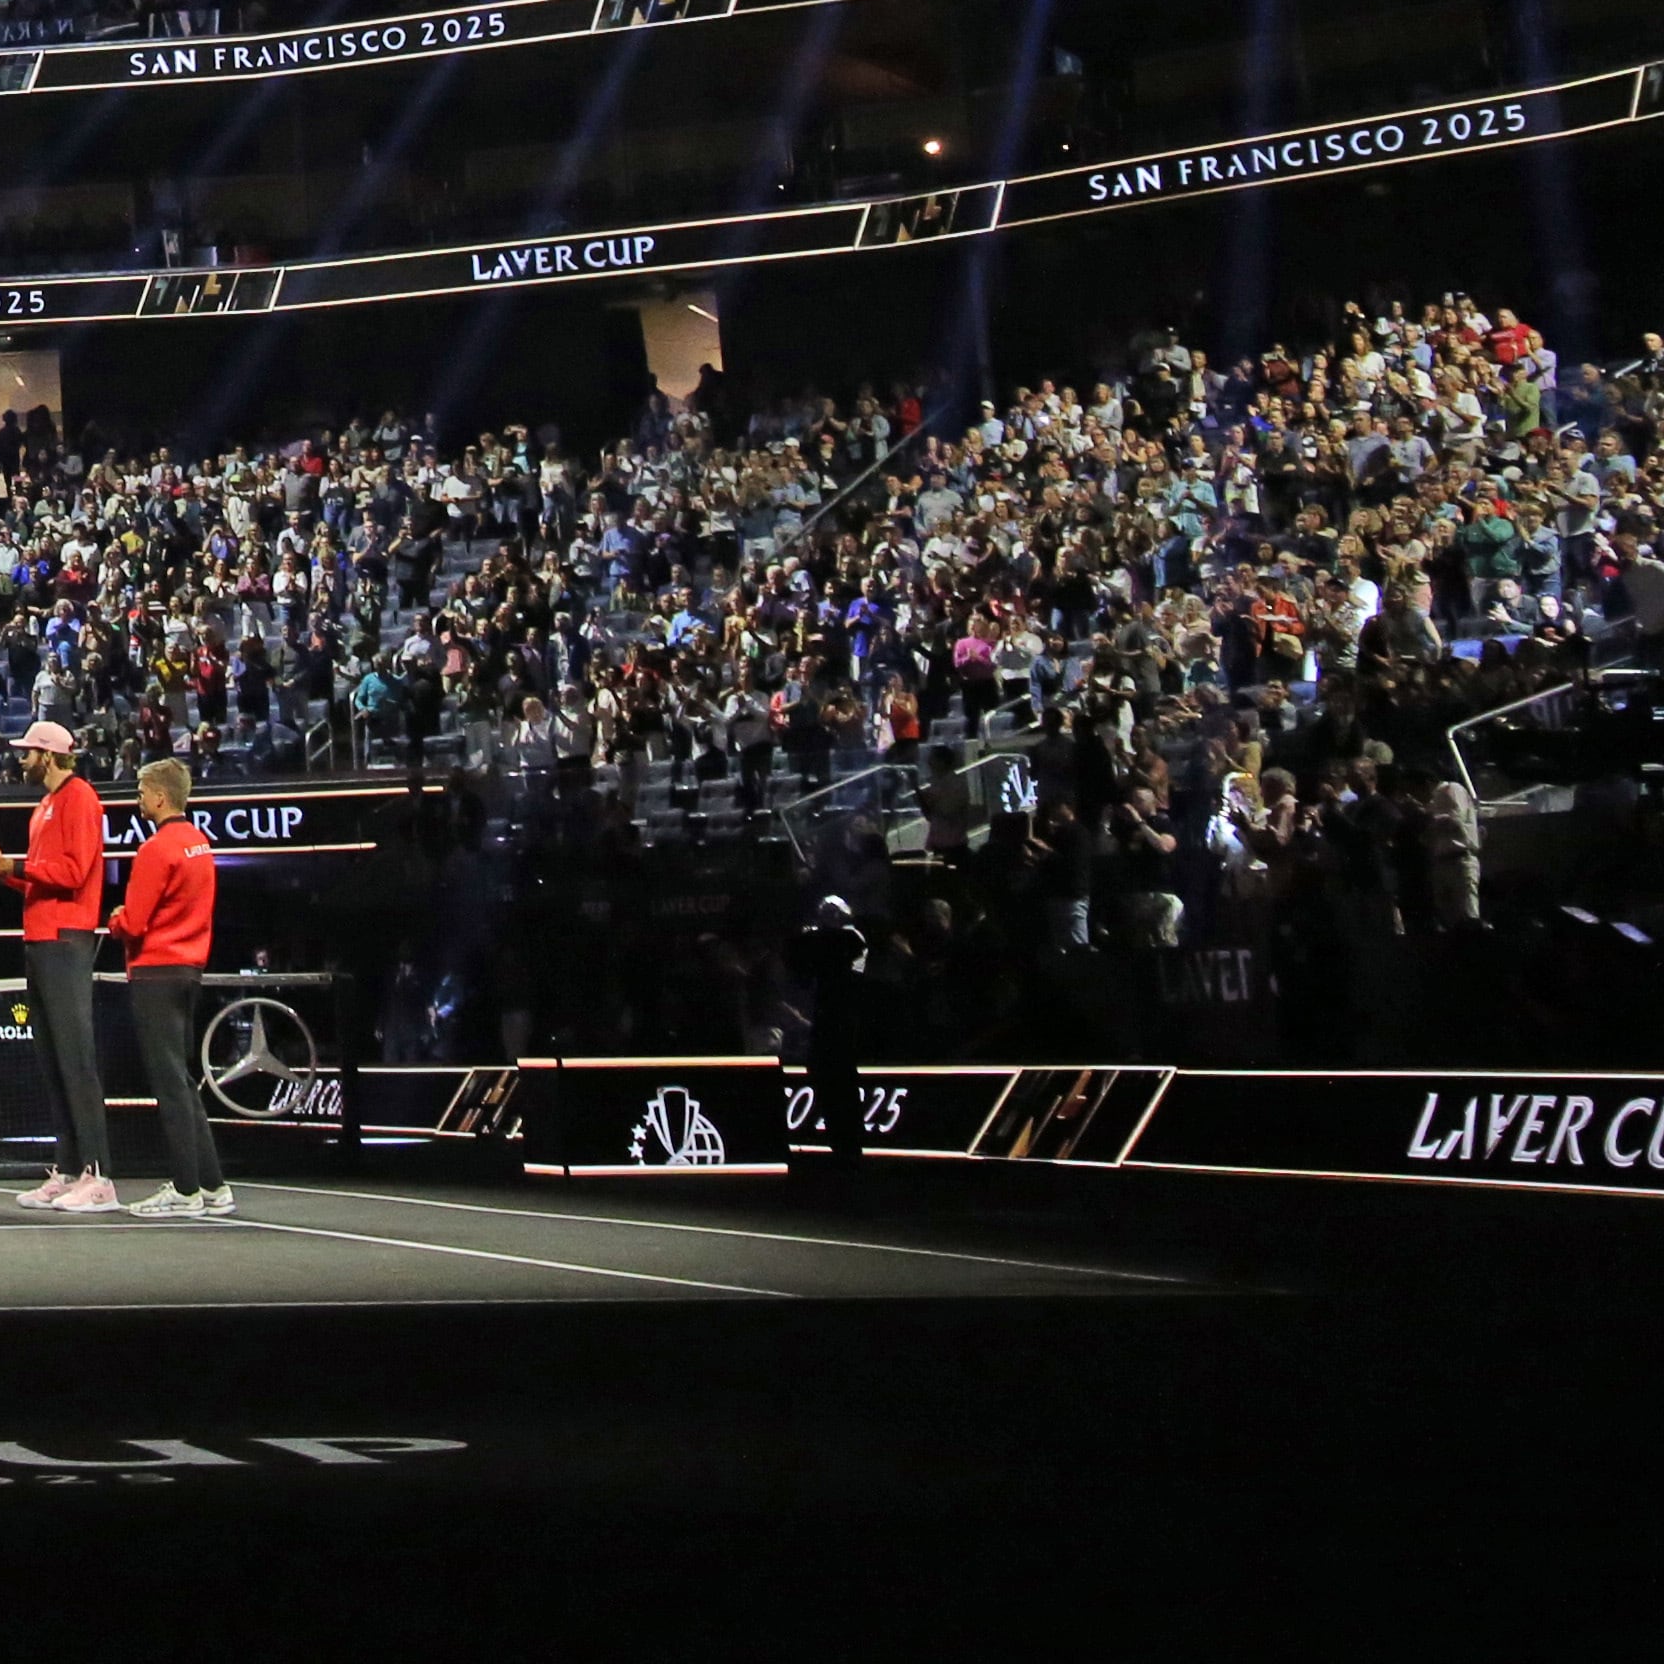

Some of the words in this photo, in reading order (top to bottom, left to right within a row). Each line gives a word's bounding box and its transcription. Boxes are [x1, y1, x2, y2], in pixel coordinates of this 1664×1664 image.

[129, 48, 197, 76] SAN
[213, 26, 407, 71] FRANCISCO
[420, 12, 505, 46] 2025
[1088, 164, 1162, 201] SAN
[1178, 124, 1405, 185] FRANCISCO
[1421, 104, 1526, 146] 2025
[471, 244, 572, 282] LAVER
[583, 235, 655, 268] CUP
[102, 810, 219, 845] LAR
[224, 806, 304, 840] CUP
[1407, 1092, 1594, 1166] LAVER
